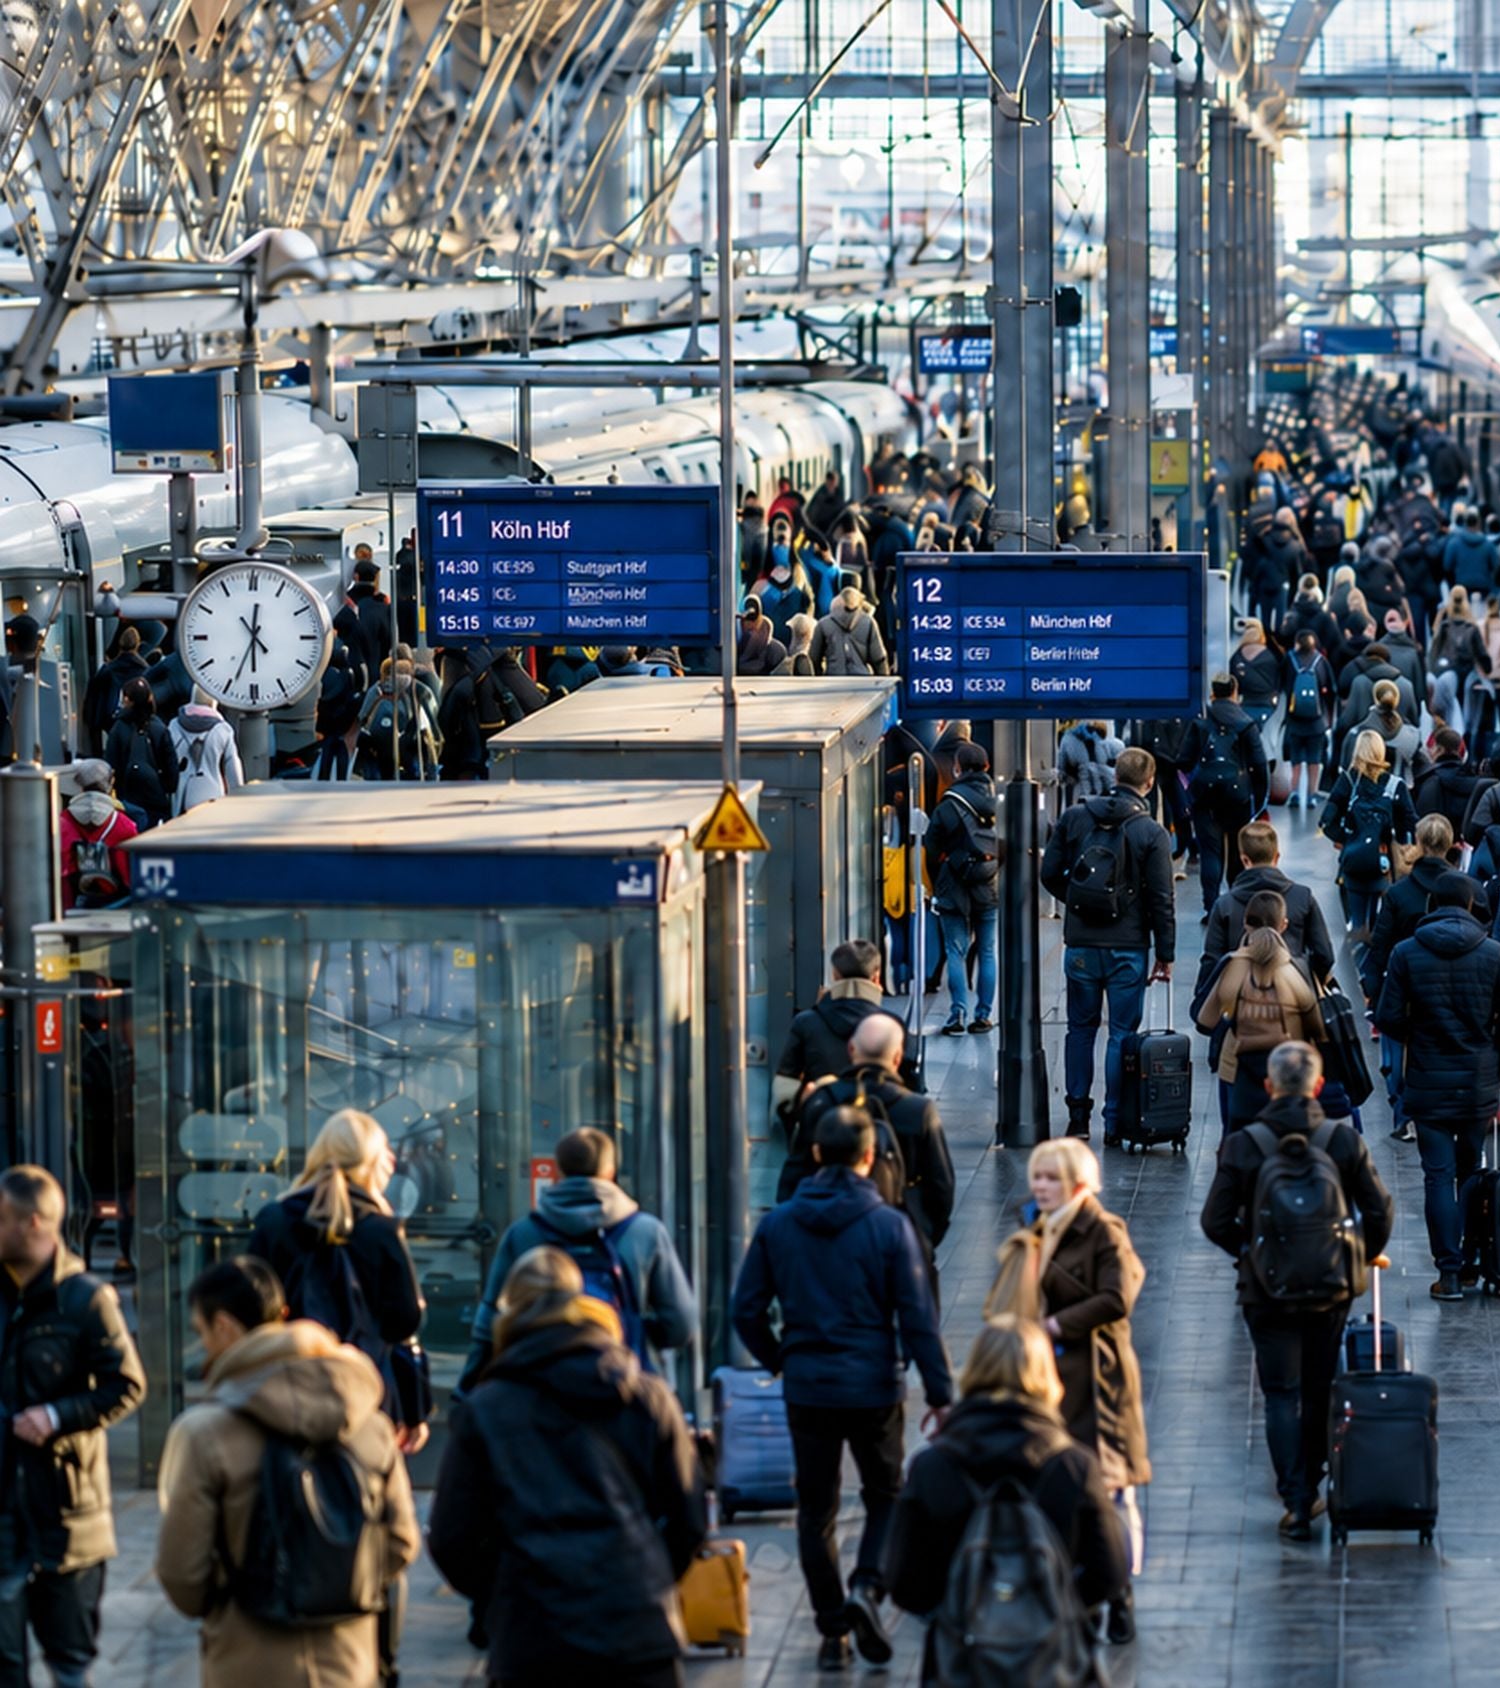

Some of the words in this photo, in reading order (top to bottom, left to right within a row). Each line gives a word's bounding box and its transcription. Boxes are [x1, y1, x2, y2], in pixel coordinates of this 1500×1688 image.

[437, 510, 463, 538] 11
[491, 519, 532, 539] Köln
[537, 519, 571, 539] Hbf
[912, 578, 942, 602] 12
[439, 615, 480, 630] 15:15
[912, 615, 952, 630] 14:32
[963, 615, 983, 629] ICE
[1030, 614, 1086, 629] München
[912, 677, 953, 694] 15:03
